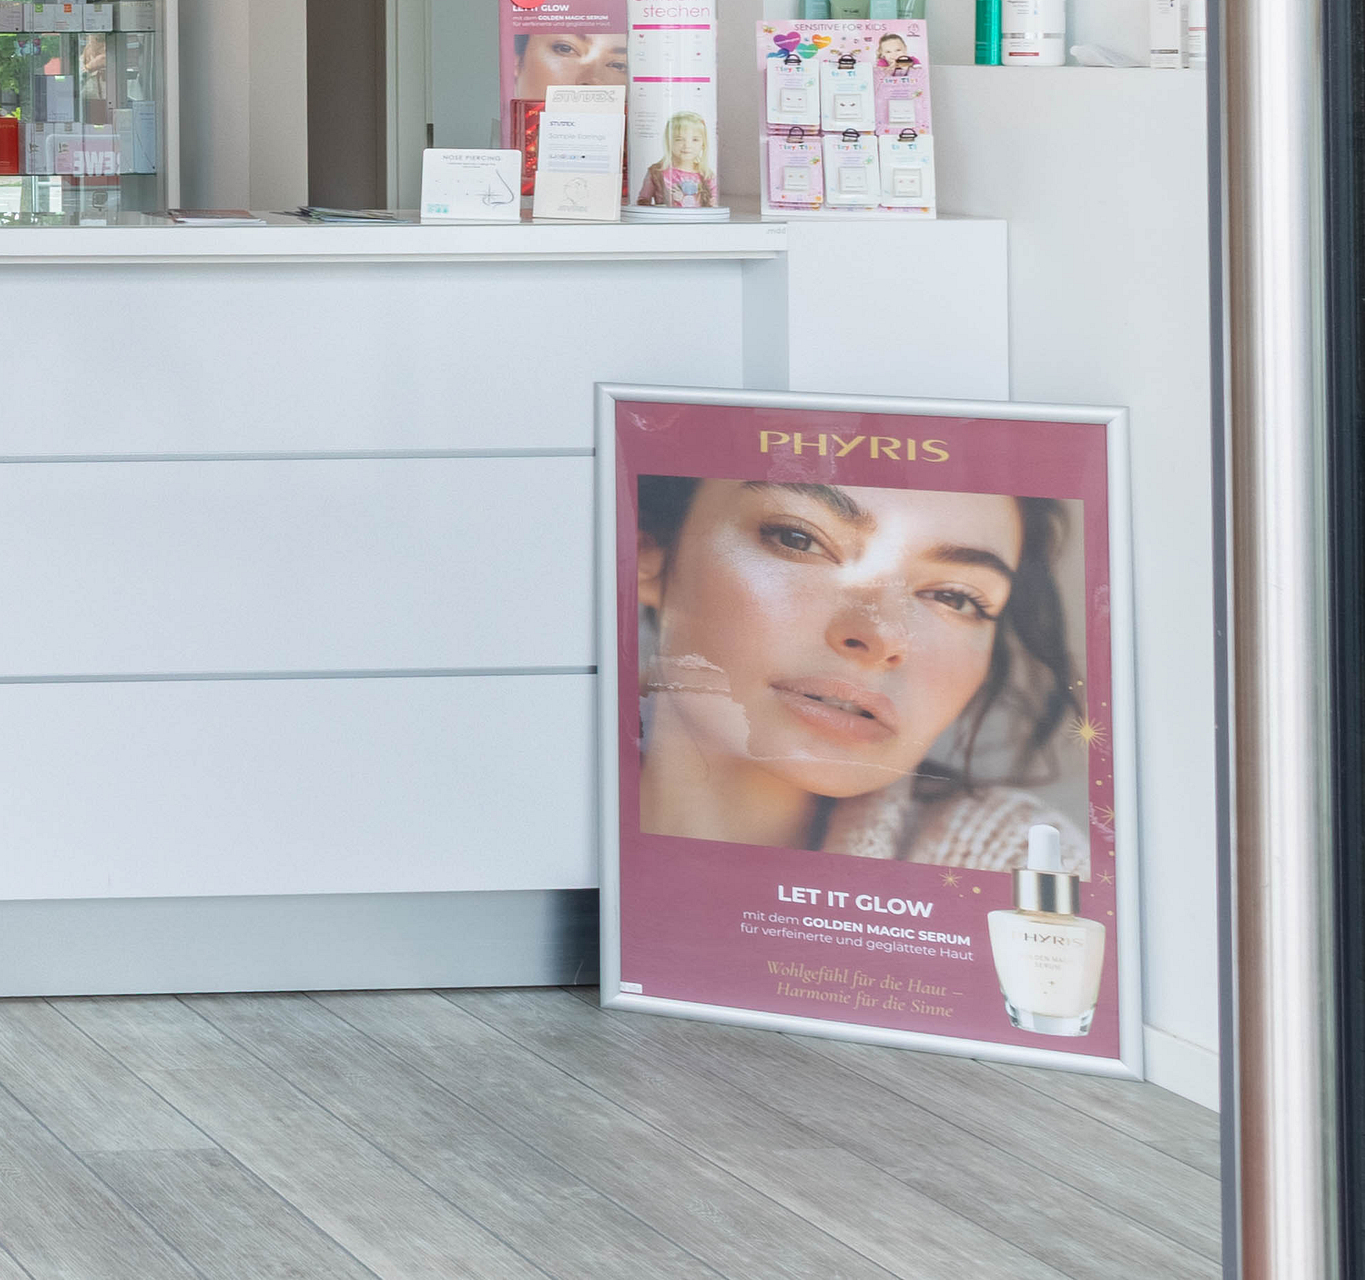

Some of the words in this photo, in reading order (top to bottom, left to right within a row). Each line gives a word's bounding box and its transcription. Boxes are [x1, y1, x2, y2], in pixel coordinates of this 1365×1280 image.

[541, 4, 569, 12] GLOW
[643, 4, 710, 18] stechen
[794, 23, 839, 31] SENSITIVE
[843, 23, 861, 31] FOR
[865, 23, 887, 31] KIDS
[760, 430, 949, 462] PHYRIS
[778, 885, 822, 905] LET
[827, 890, 849, 908] IT
[855, 894, 933, 918] GLOW
[740, 922, 758, 934] für
[761, 927, 833, 944] verfeinerte
[836, 935, 863, 947] und
[866, 938, 937, 957] geglättete
[940, 948, 974, 961] Haut
[743, 910, 765, 921] mit
[768, 912, 799, 925] dem
[802, 916, 863, 933] GOLDEN
[867, 924, 915, 939] MAGIC
[918, 930, 971, 947] SERUM
[1012, 931, 1084, 947] HYRIS
[767, 960, 849, 984] Wohlgefühl
[851, 970, 876, 989] für
[879, 974, 903, 991] die
[907, 978, 947, 997] Haut
[776, 982, 851, 1005] Harmonie
[853, 990, 879, 1010] für
[882, 995, 905, 1011] die
[910, 998, 953, 1018] Sinne
